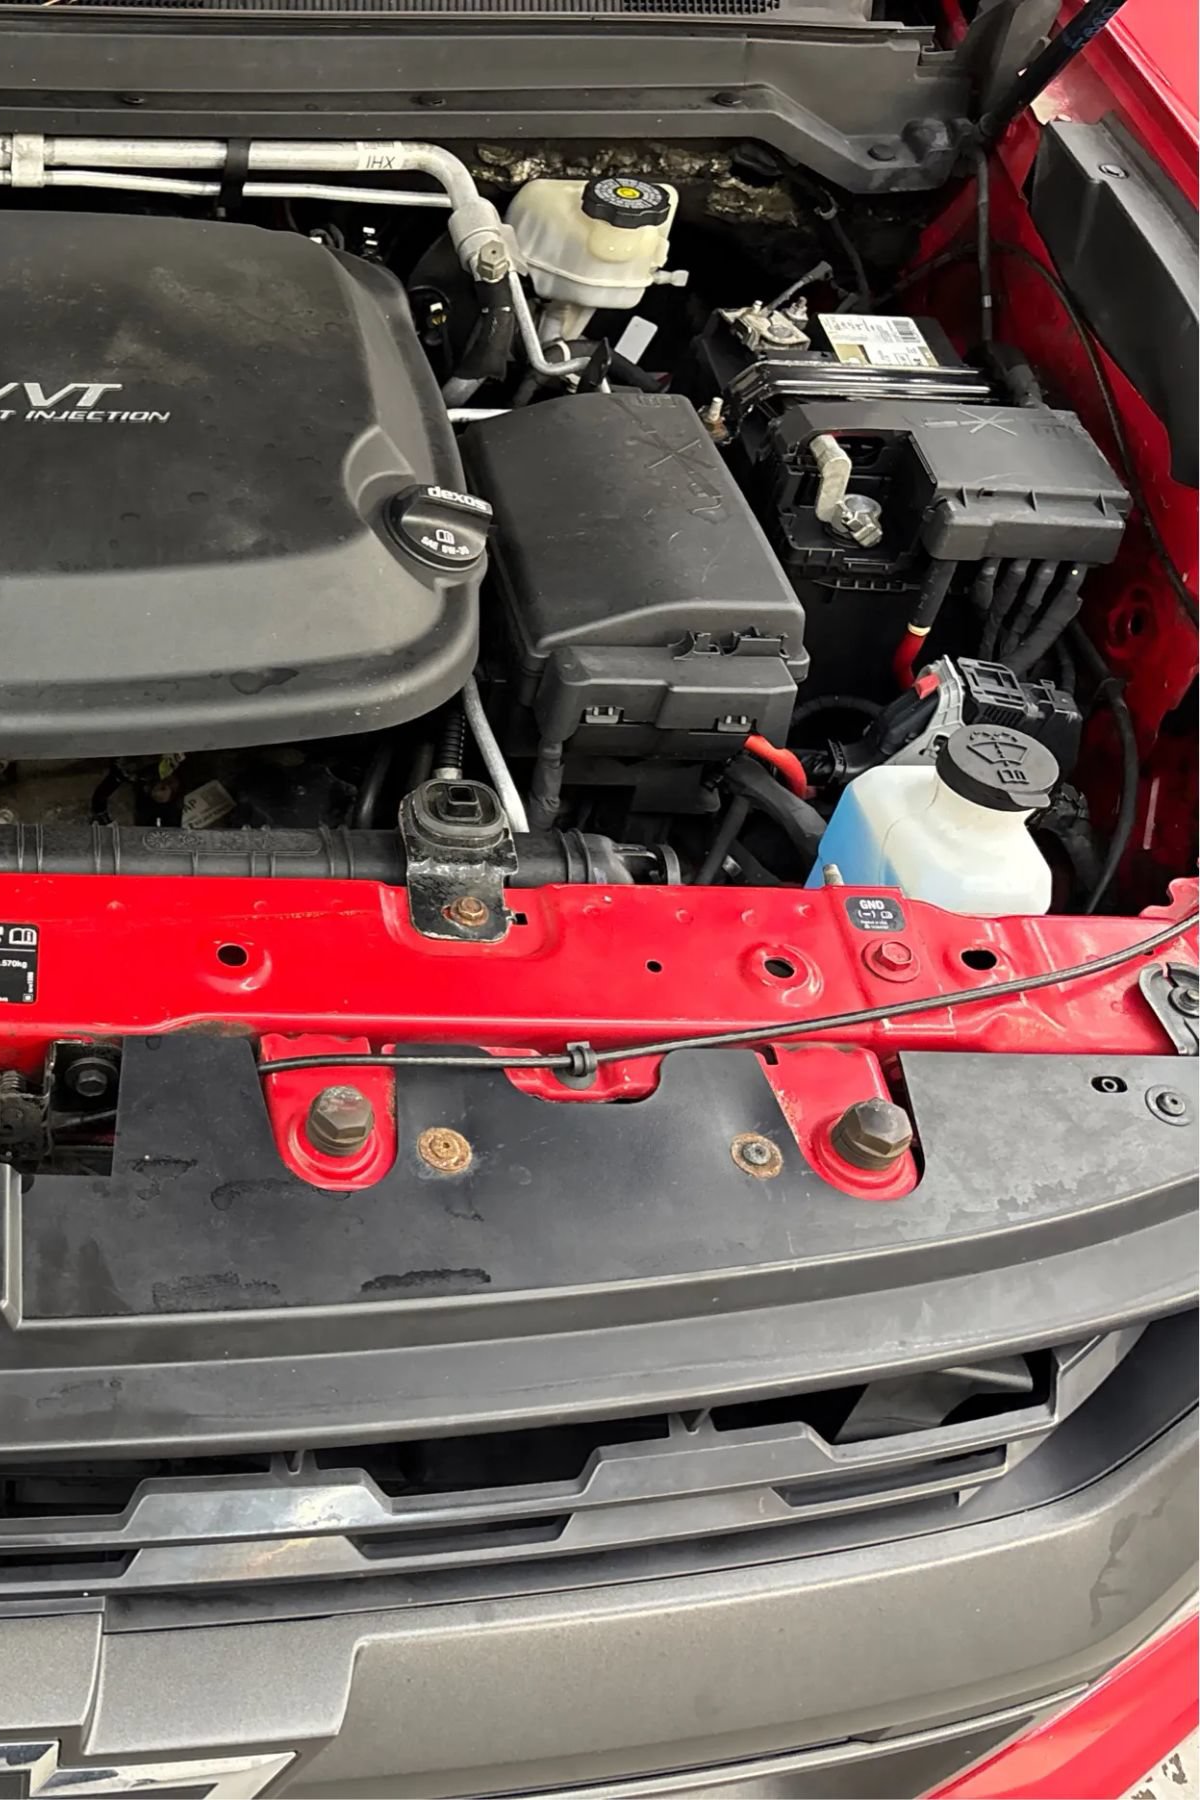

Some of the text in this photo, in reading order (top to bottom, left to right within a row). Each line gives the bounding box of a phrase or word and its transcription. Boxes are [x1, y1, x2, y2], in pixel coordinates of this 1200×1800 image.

[366, 155, 395, 169] IHX
[25, 409, 170, 423] INJECTION
[427, 486, 490, 511] dexos
[859, 899, 885, 910] GND
